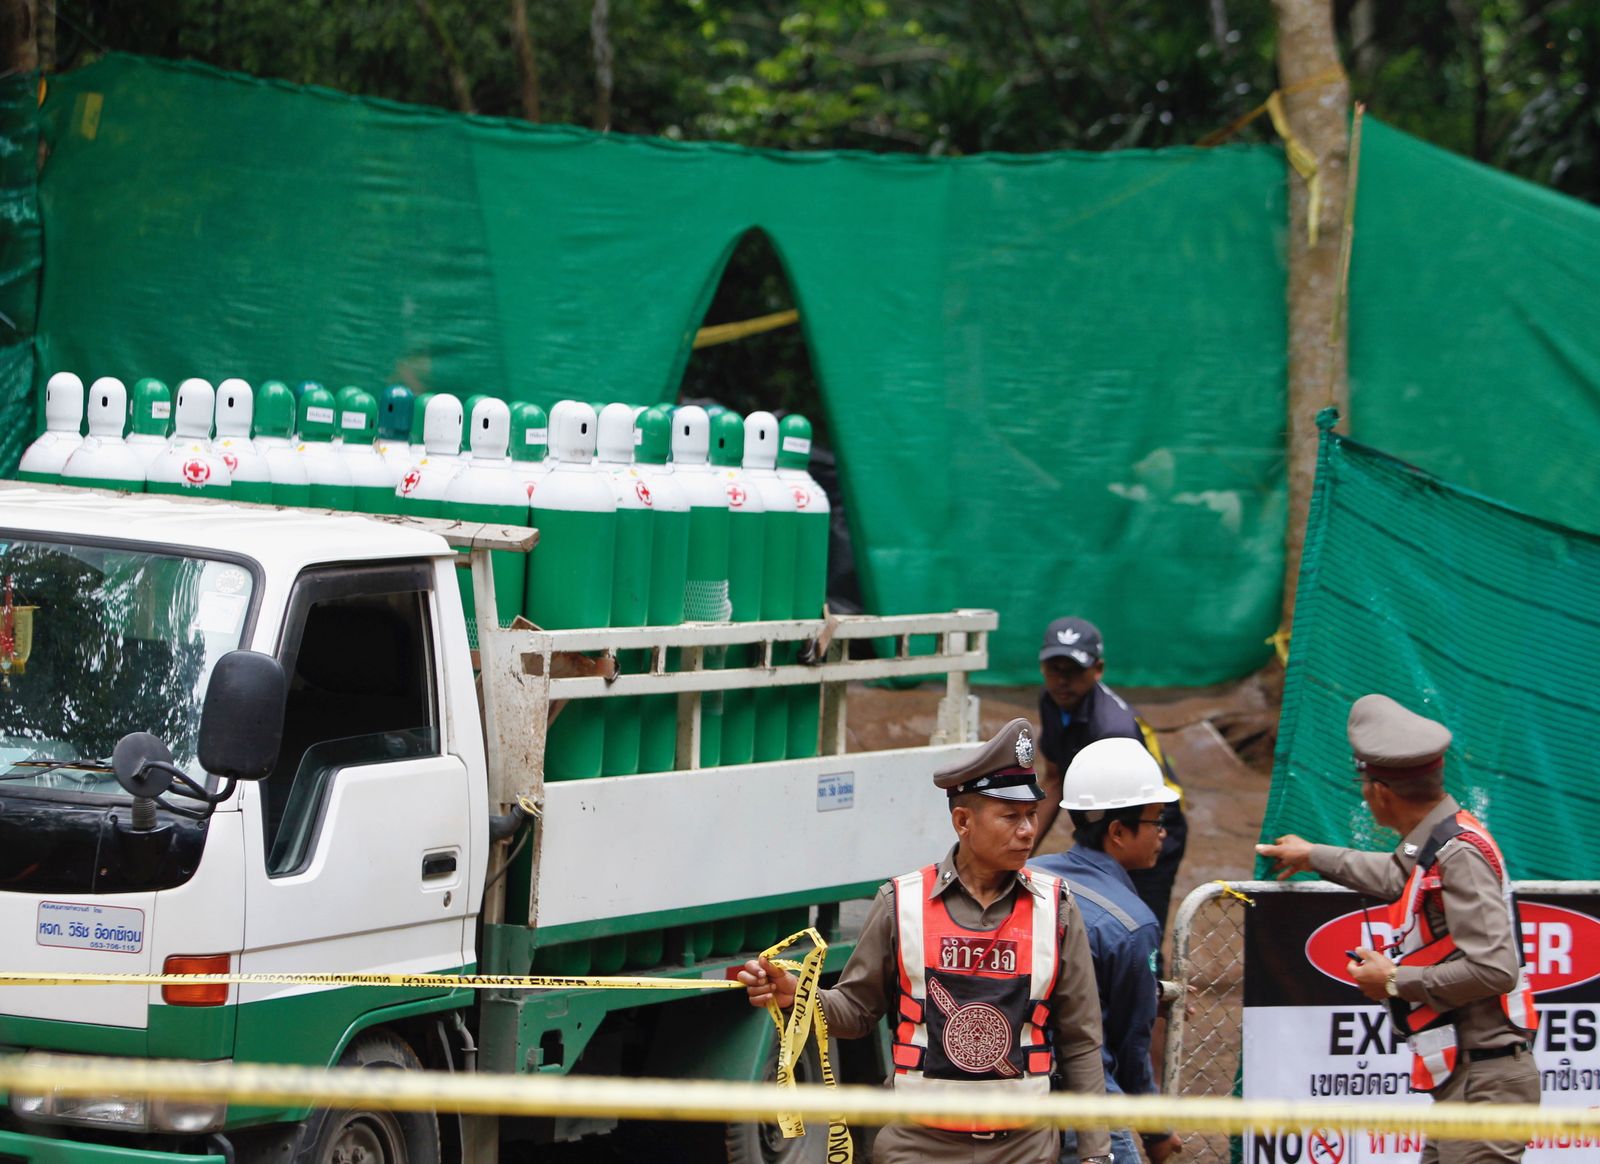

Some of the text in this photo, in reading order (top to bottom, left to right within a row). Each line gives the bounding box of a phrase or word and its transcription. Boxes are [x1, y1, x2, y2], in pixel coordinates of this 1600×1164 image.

[68, 922, 90, 938] วิรัช
[90, 941, 136, 951] 053-706-115
[942, 937, 1017, 971] ตำรวจ
[1253, 1124, 1304, 1164] NO
